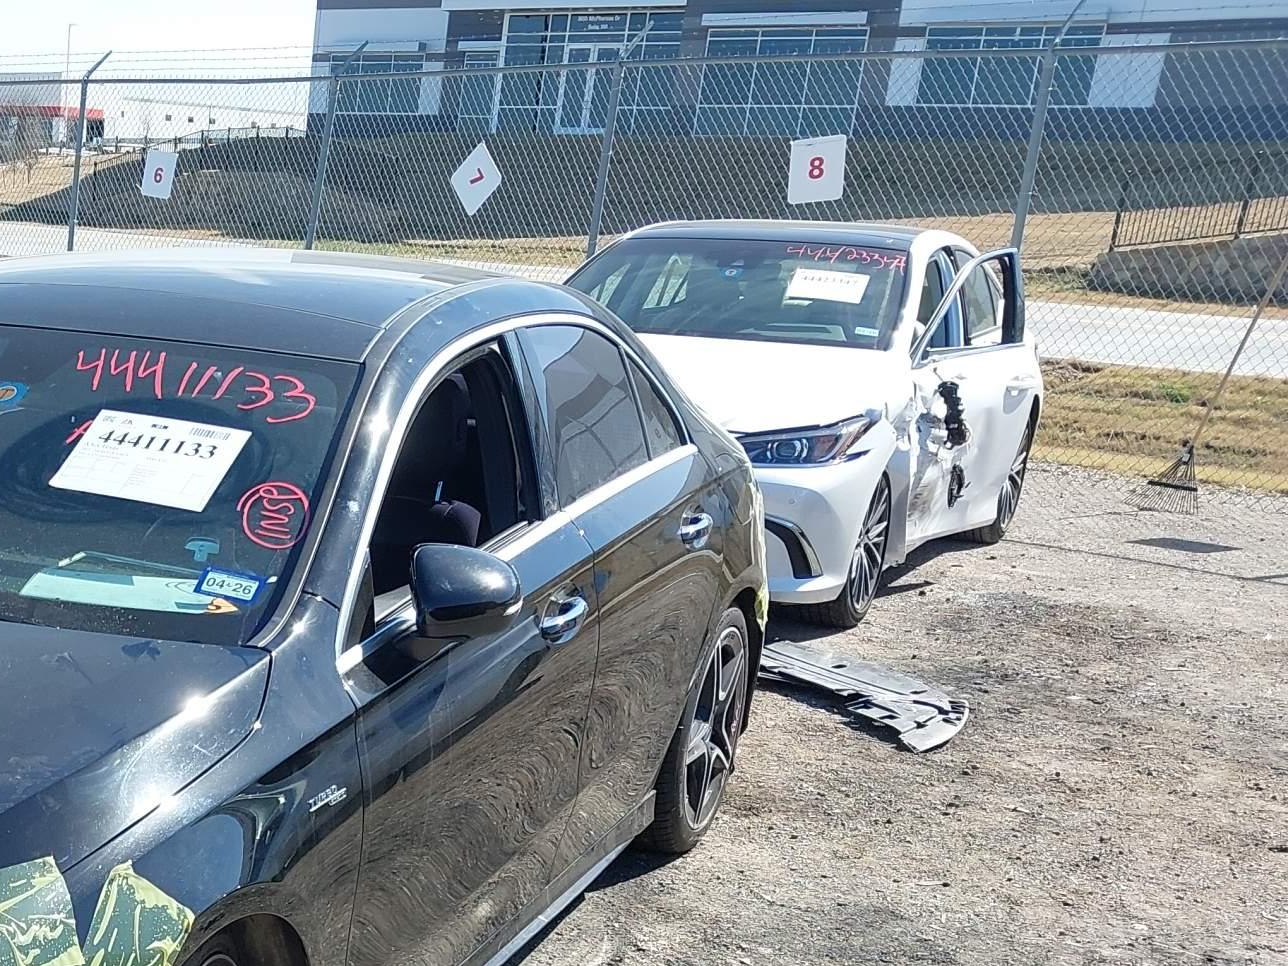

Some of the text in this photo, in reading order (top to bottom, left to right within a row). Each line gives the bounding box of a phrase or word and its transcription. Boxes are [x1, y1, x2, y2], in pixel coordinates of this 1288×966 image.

[153, 167, 164, 184] 6
[469, 167, 485, 185] 7
[808, 156, 825, 180] 8
[75, 348, 317, 424] 44411133
[98, 430, 219, 460] 44411133
